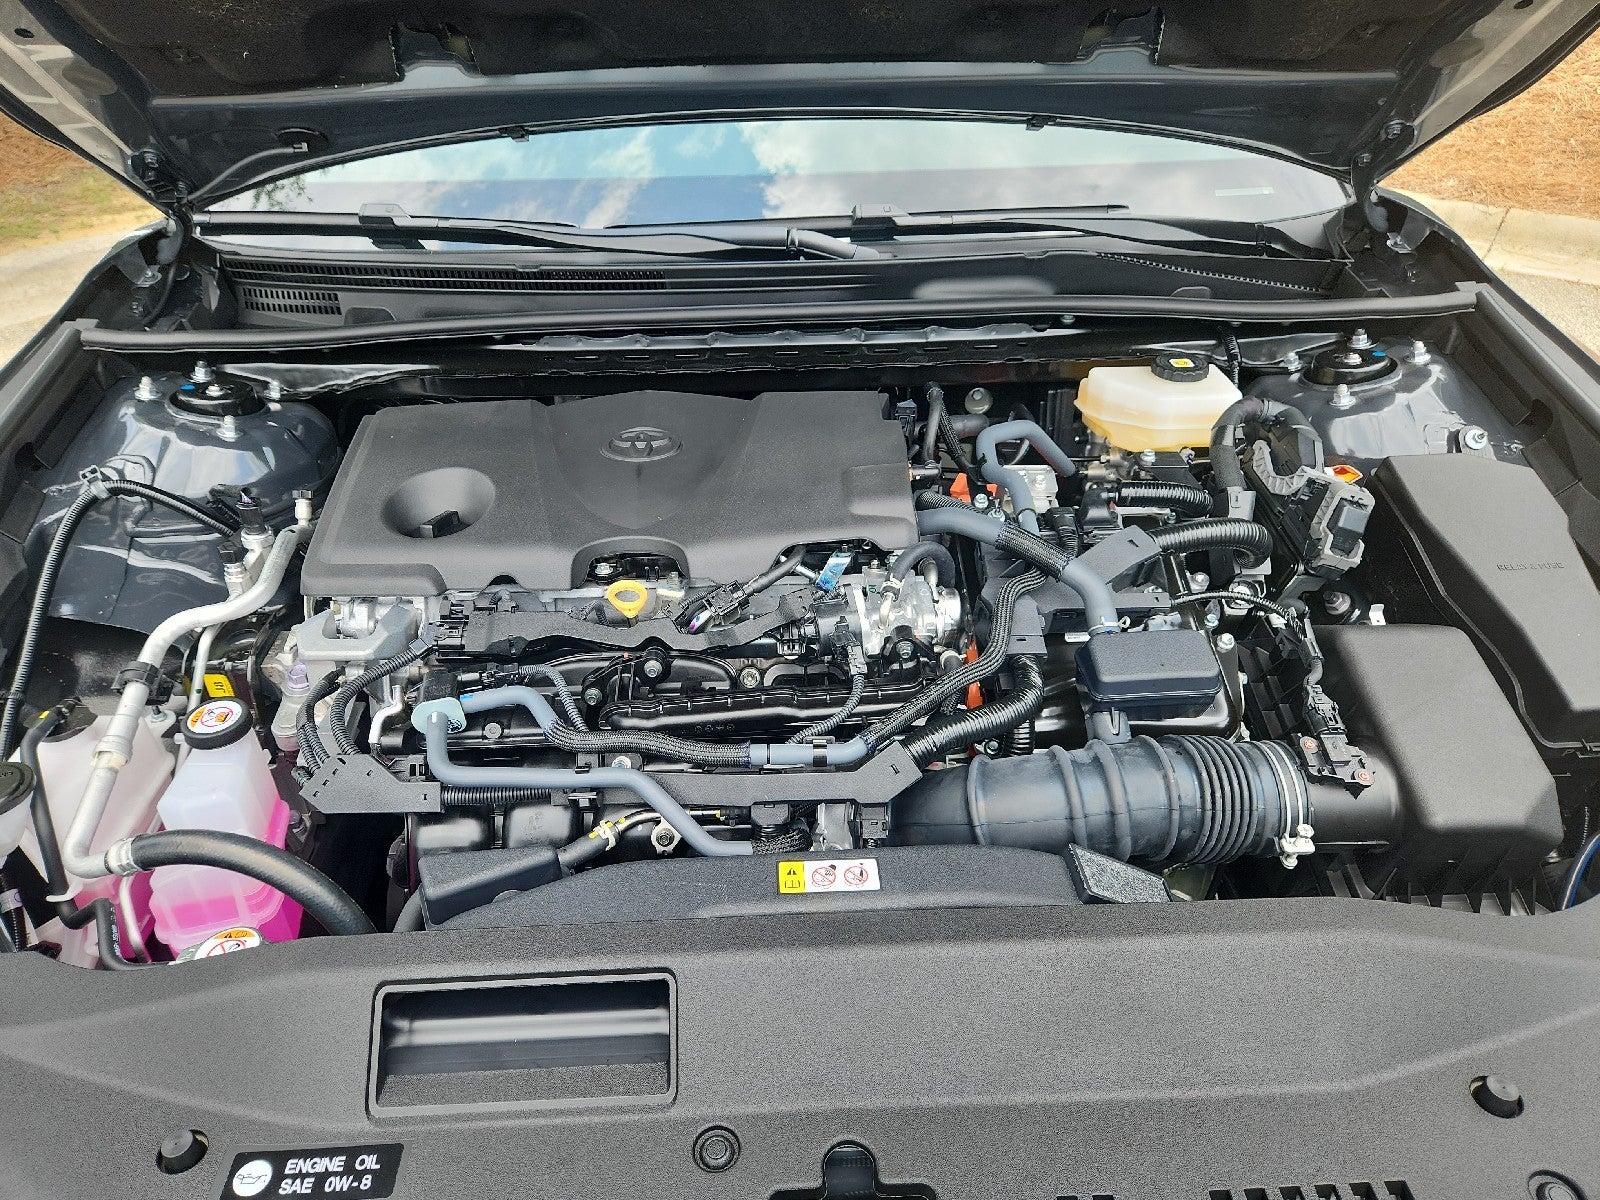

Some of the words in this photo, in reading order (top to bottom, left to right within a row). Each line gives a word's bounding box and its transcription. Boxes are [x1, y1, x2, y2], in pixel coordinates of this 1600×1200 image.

[1496, 563, 1527, 571] RELAY
[1538, 561, 1565, 570] FUSE
[284, 1156, 347, 1174] ENGINE
[354, 1154, 381, 1170] OIL
[278, 1177, 315, 1195] SAE
[324, 1175, 372, 1192] 0W-8
